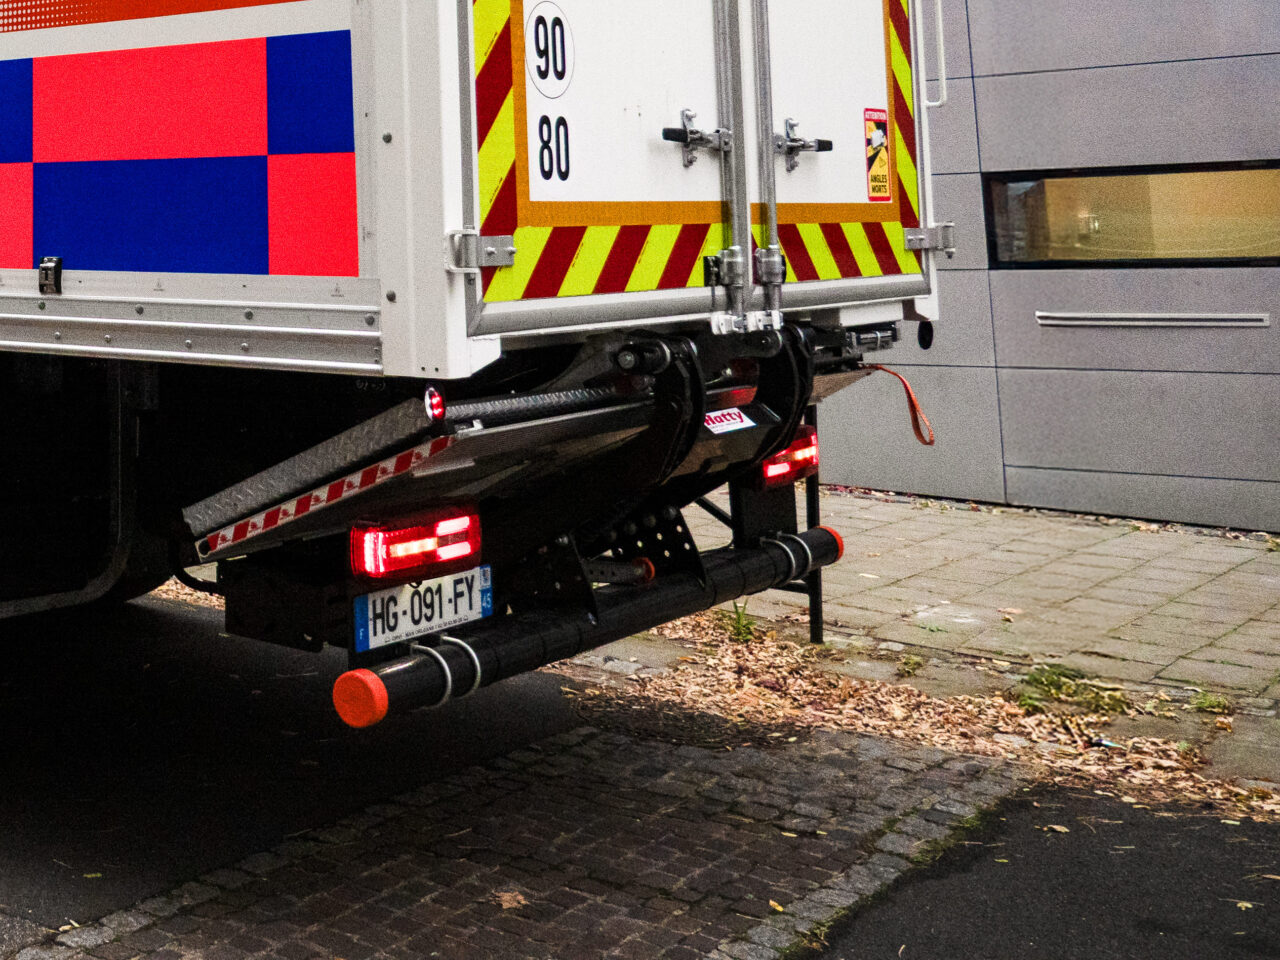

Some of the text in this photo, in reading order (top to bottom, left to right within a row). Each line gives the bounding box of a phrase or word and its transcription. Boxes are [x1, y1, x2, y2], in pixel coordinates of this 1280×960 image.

[534, 15, 566, 81] 90
[538, 114, 570, 182] 80
[870, 174, 887, 183] ANGLES
[871, 184, 887, 193] MORTS
[372, 574, 475, 637] HG-091-FY
[482, 593, 492, 609] 45
